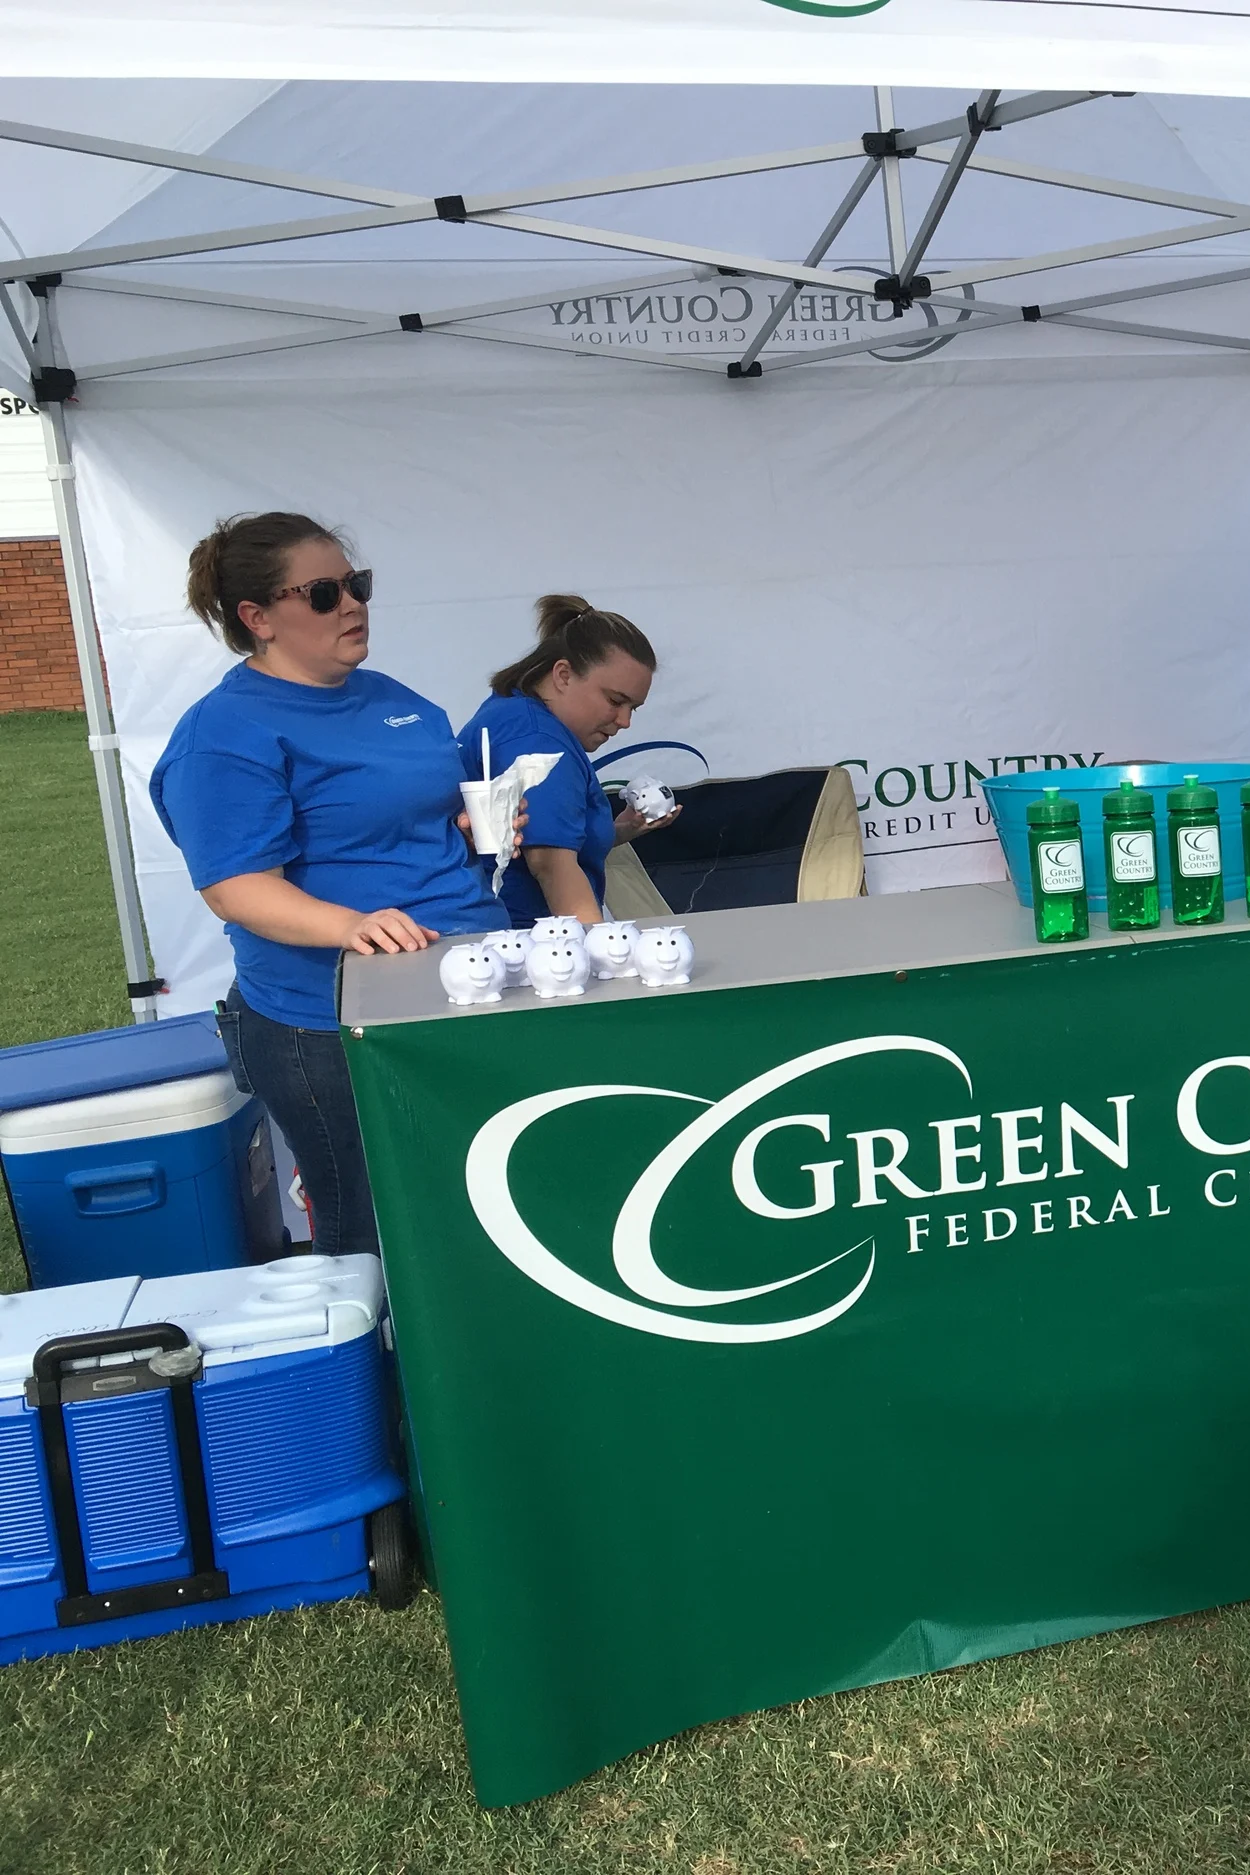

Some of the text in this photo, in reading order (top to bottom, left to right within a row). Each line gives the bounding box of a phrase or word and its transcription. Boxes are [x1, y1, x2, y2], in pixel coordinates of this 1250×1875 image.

[864, 811, 957, 838] REDIT
[1121, 858, 1148, 867] GREEN
[1188, 852, 1215, 861] GREEN
[1050, 868, 1077, 877] GREEN
[731, 1095, 1135, 1221] GREEN
[904, 1185, 1171, 1254] FEDERAL
